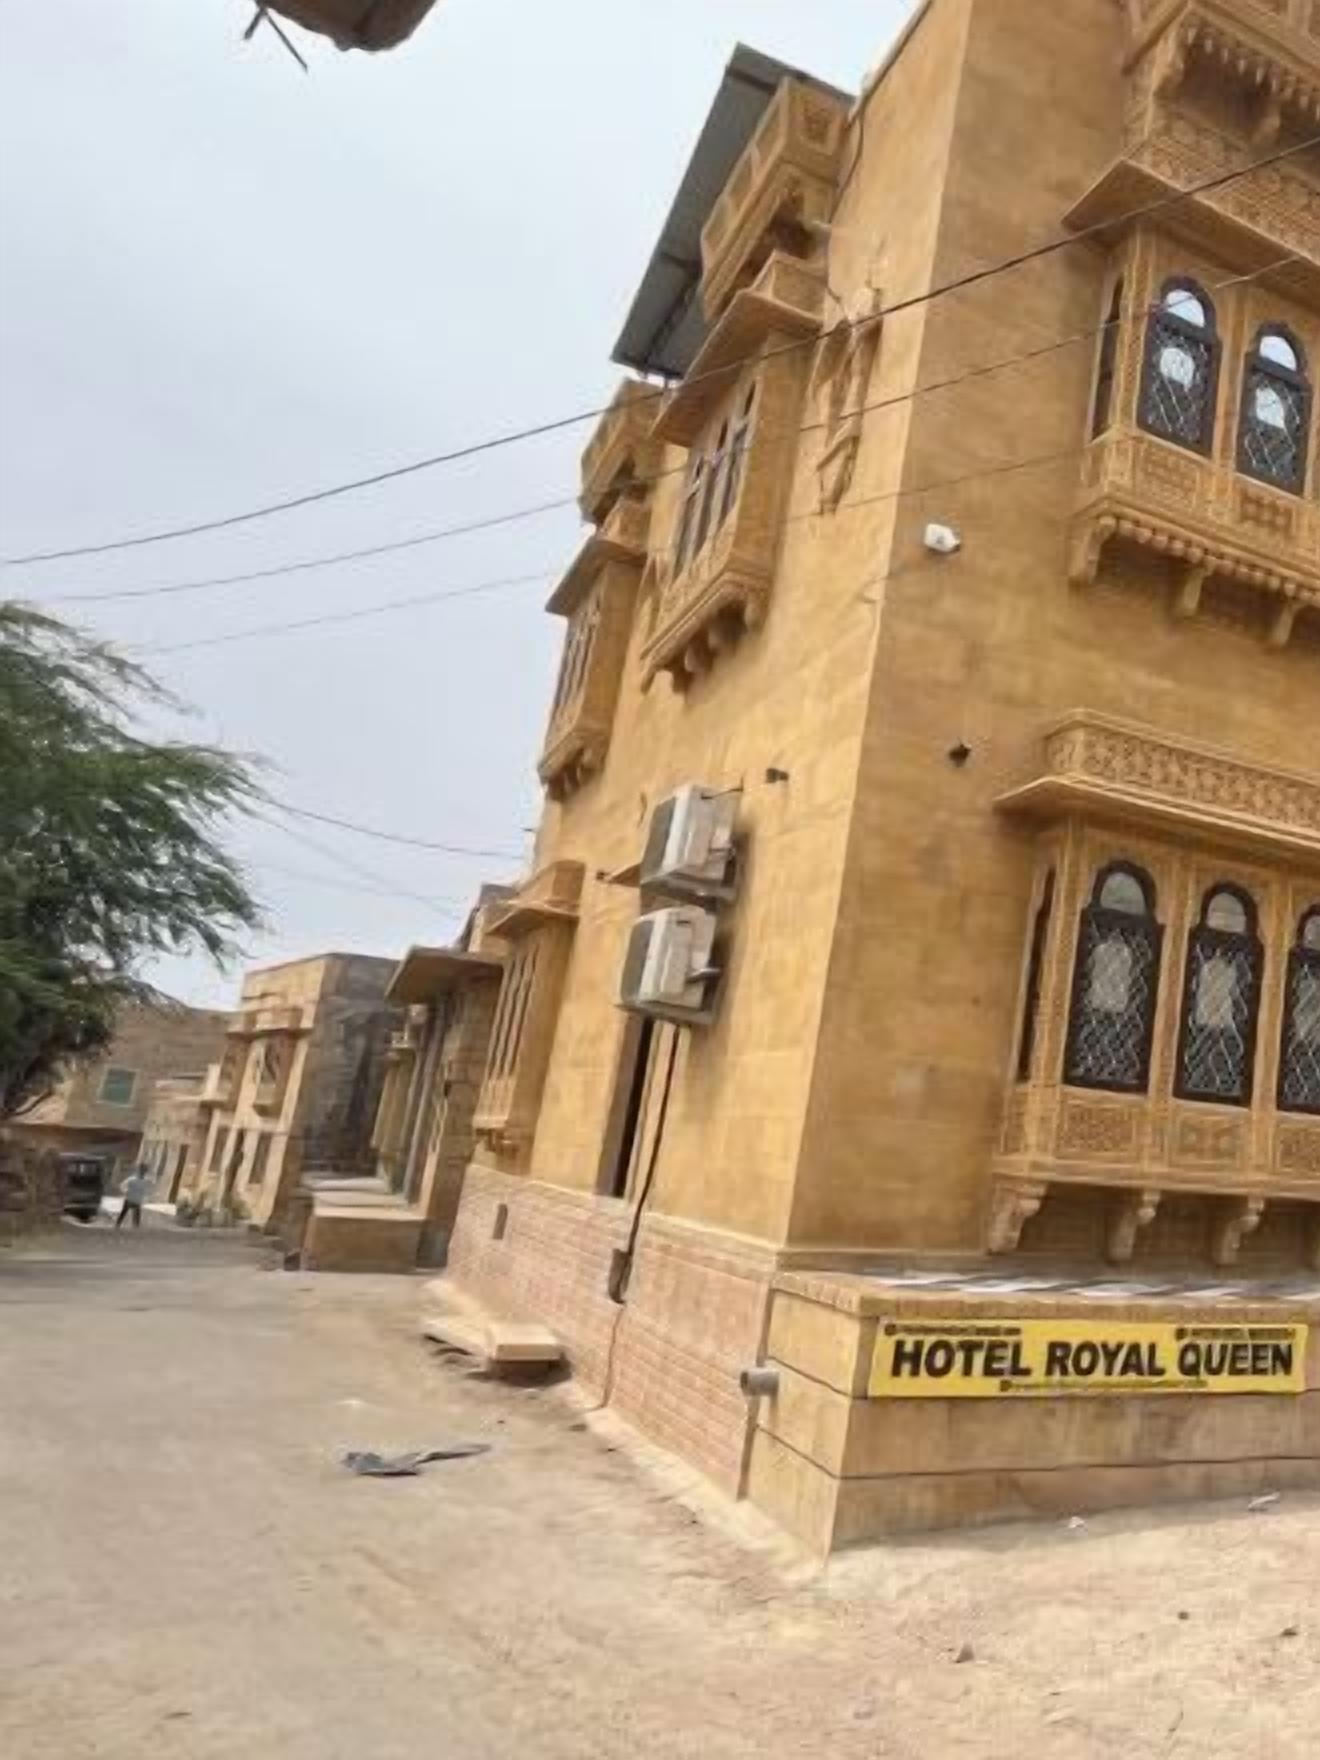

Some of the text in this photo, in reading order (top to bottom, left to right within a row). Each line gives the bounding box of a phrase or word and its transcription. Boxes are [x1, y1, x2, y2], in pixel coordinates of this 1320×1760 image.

[890, 1339, 1293, 1378] HOTEL ROYAL QUEEN
